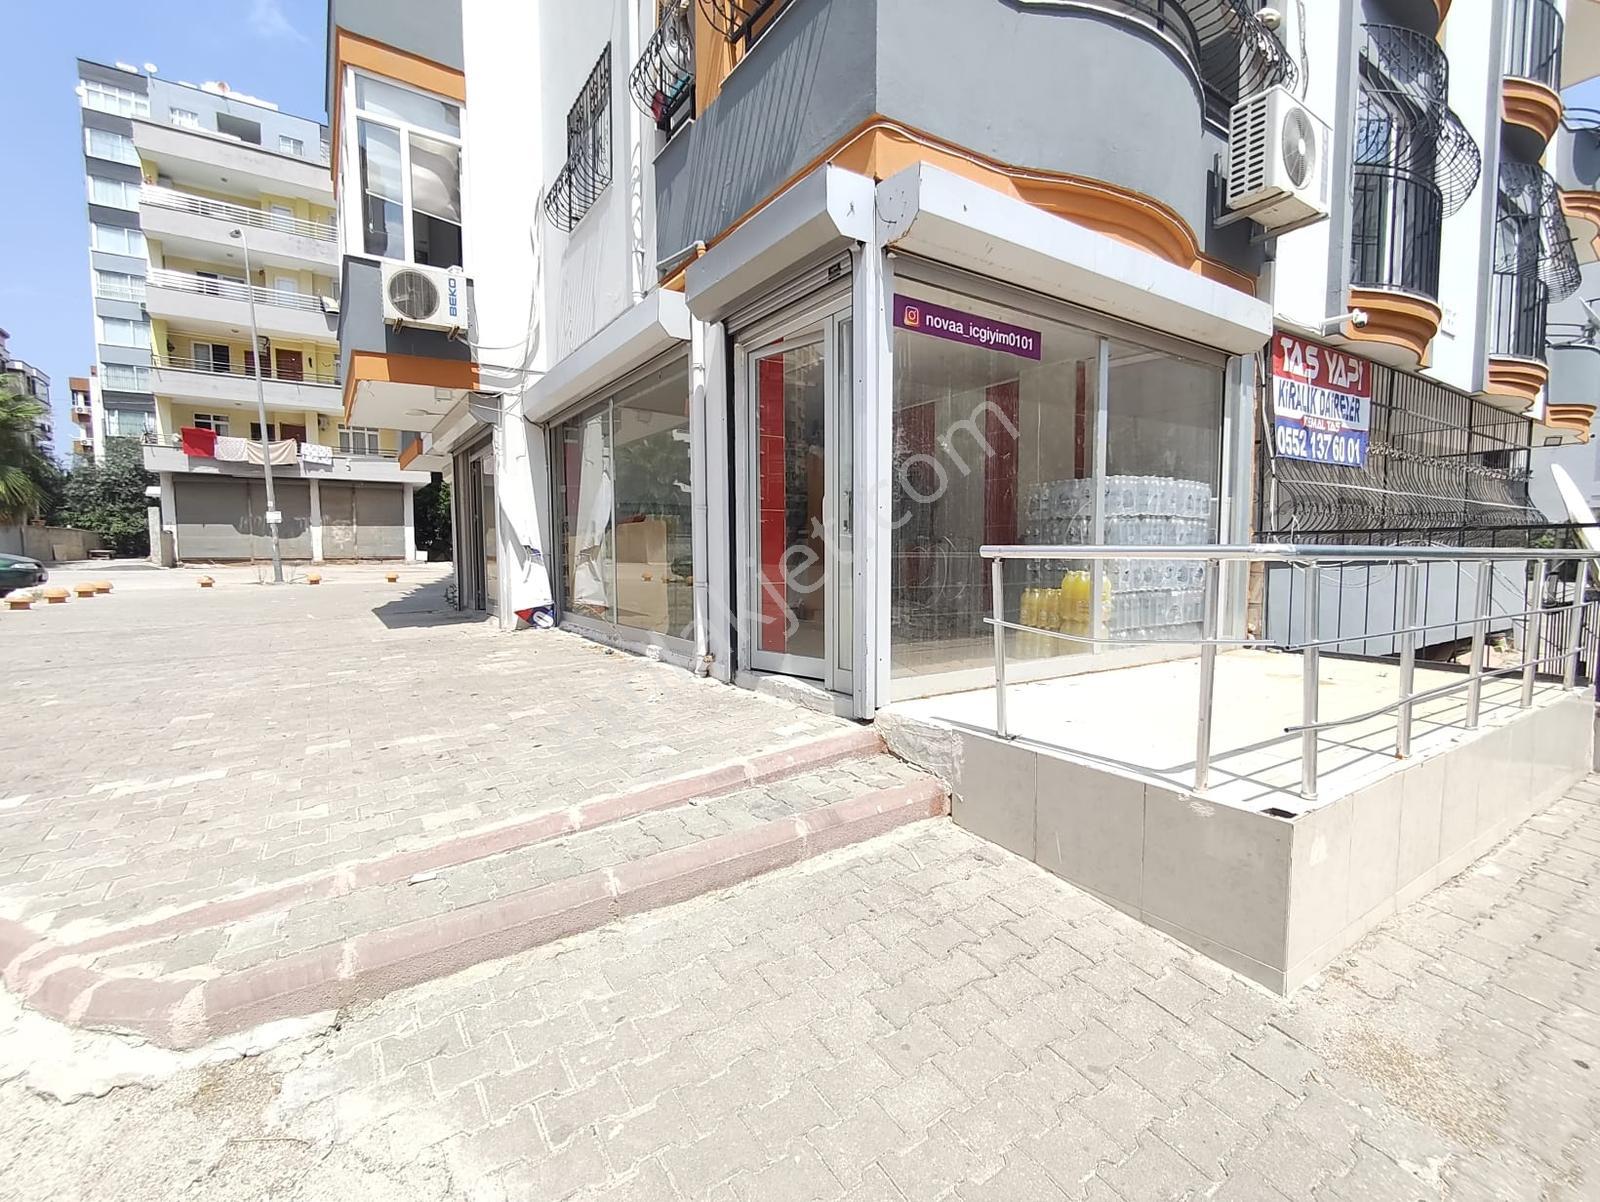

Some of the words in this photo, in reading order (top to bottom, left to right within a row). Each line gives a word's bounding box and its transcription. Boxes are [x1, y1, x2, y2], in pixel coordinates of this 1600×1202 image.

[448, 278, 458, 317] BEKO
[925, 314, 1033, 351] novaa_icgiyim0101
[1324, 350, 1364, 391] YAPI
[1277, 425, 1309, 458] 0552
[1310, 431, 1332, 460] 137
[1332, 434, 1345, 463] 60
[1347, 437, 1361, 464] 01
